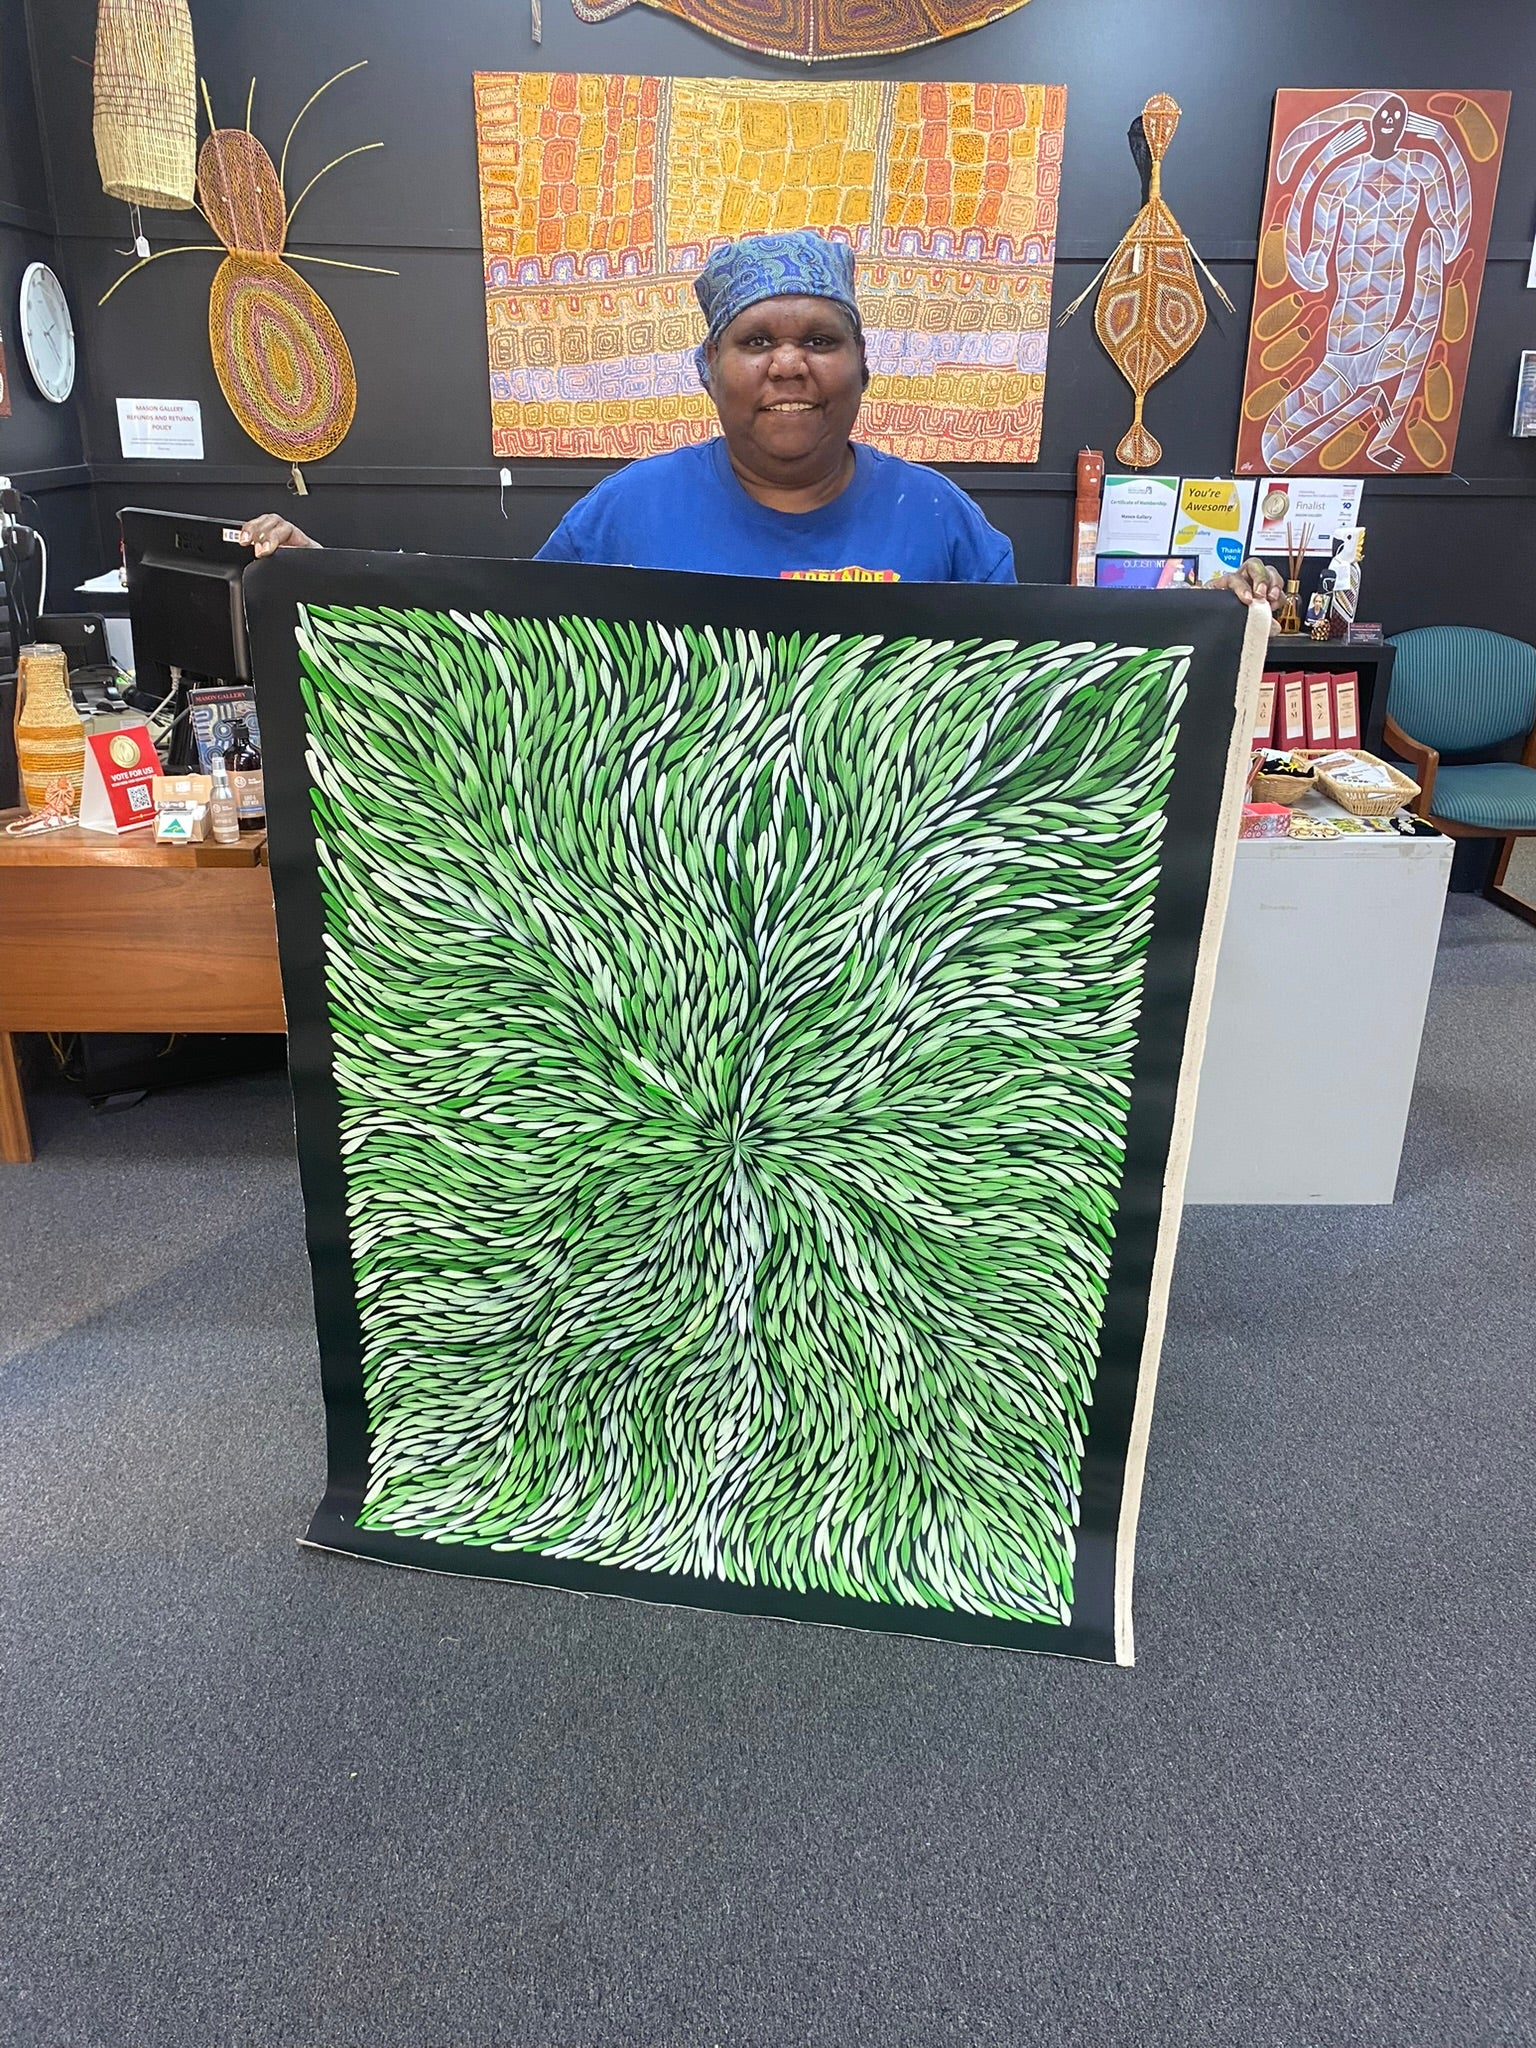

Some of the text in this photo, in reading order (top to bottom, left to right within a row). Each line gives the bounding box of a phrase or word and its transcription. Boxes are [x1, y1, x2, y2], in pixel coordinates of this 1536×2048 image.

[1185, 502, 1234, 513] Awesome
[1295, 501, 1326, 511] Finalist
[1221, 547, 1242, 555] Thank
[1224, 554, 1237, 562] you
[791, 568, 884, 582] ADELAIDE
[194, 691, 246, 702] MASON GALLERY
[111, 766, 154, 782] VOTE FOR US!
